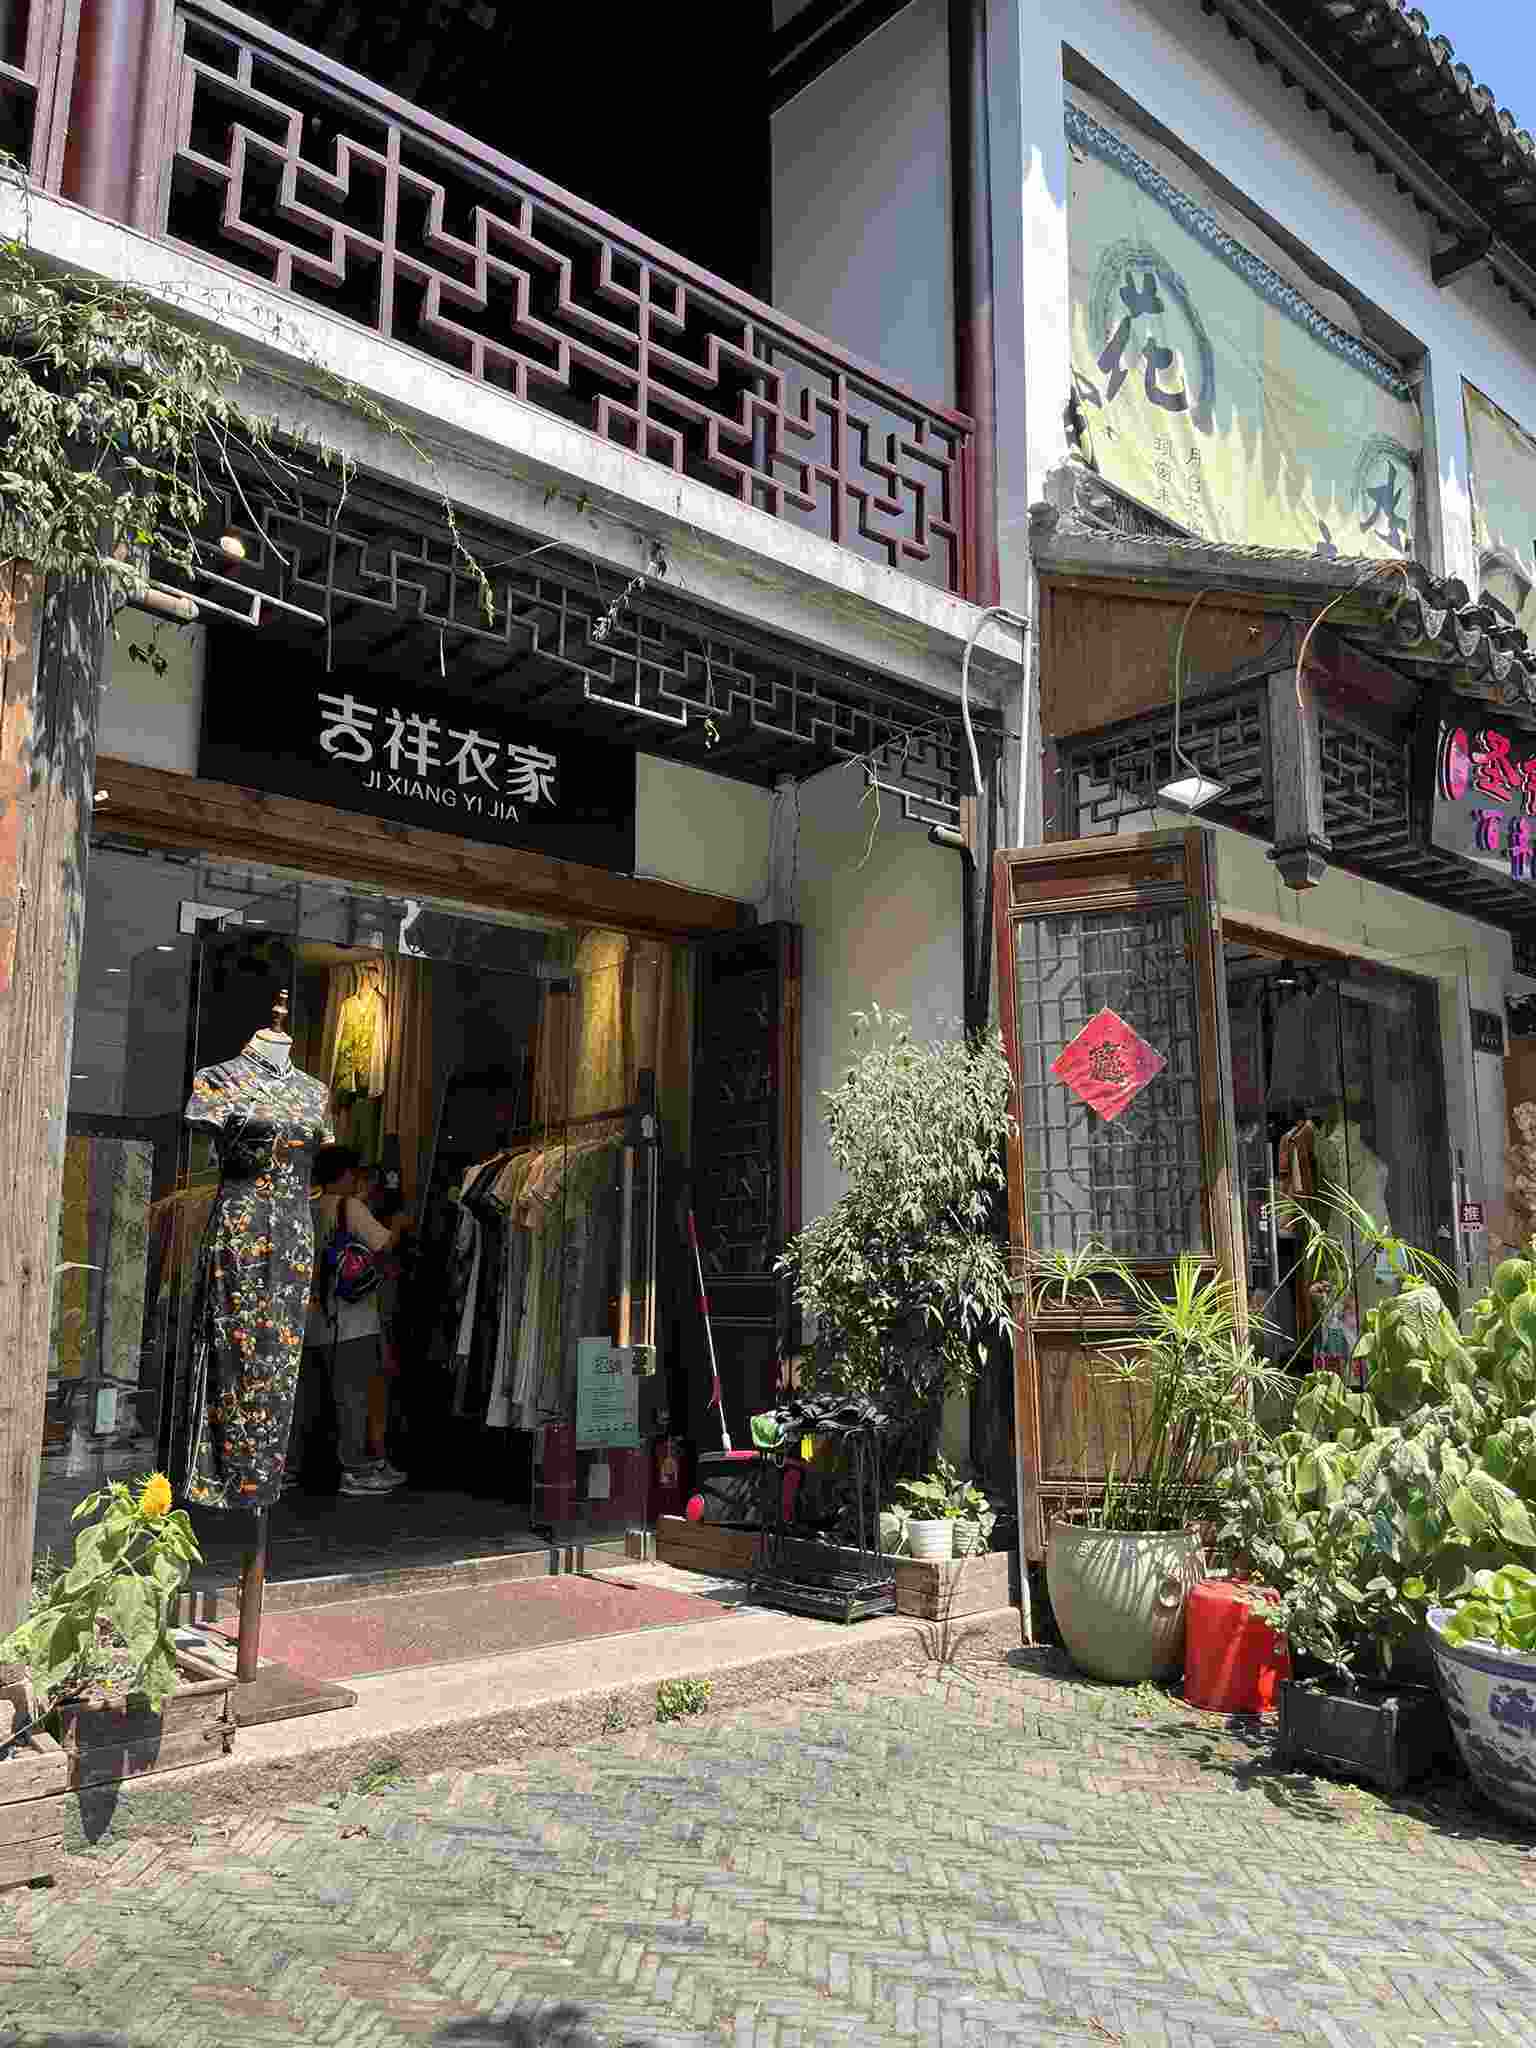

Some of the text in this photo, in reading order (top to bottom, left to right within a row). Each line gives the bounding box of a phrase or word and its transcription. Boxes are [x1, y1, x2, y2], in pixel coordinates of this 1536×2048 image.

[318, 692, 557, 806] 吉祥衣家
[361, 769, 520, 823] JI XIANG YI JIA
